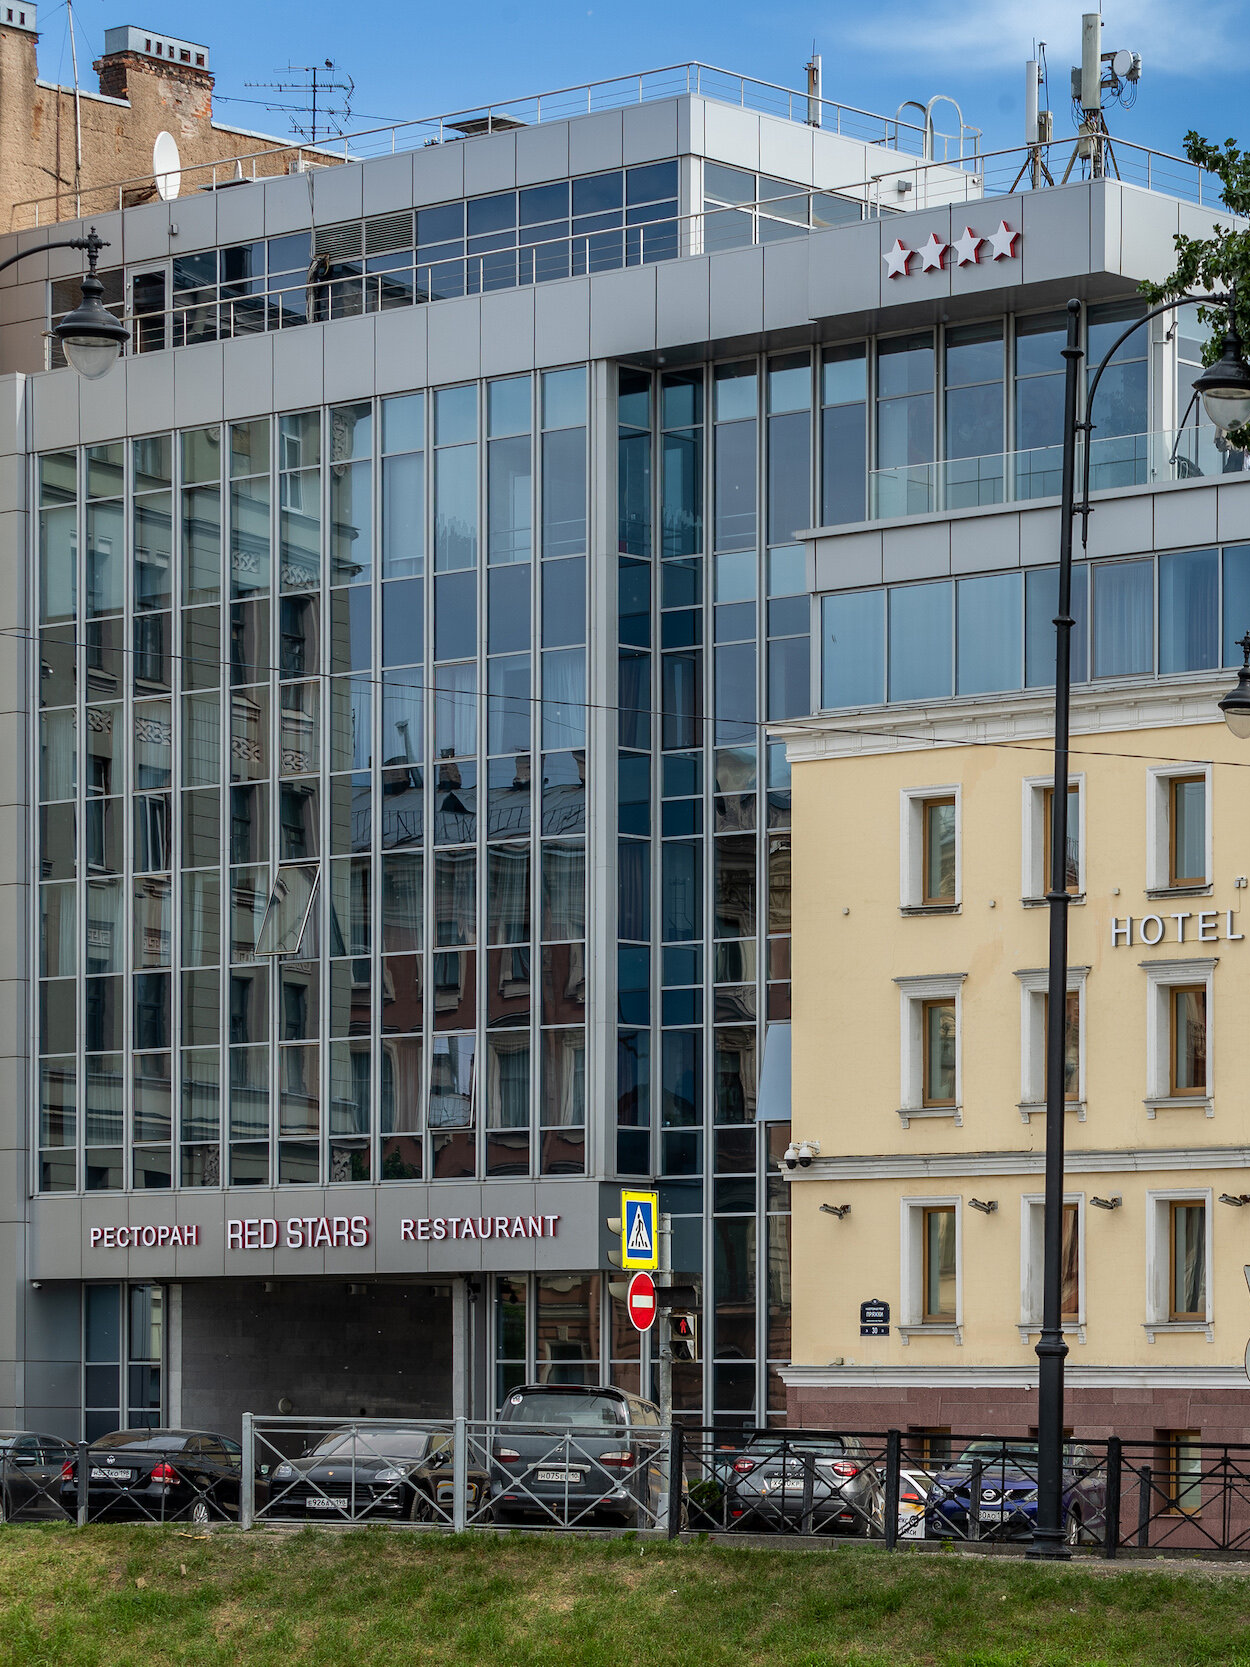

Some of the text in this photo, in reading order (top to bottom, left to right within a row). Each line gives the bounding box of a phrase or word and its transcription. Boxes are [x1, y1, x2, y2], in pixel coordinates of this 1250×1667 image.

[1111, 909, 1245, 947] HOTEL
[90, 1215, 560, 1249] РЕСТОРАН RED STARS RESTAURANT
